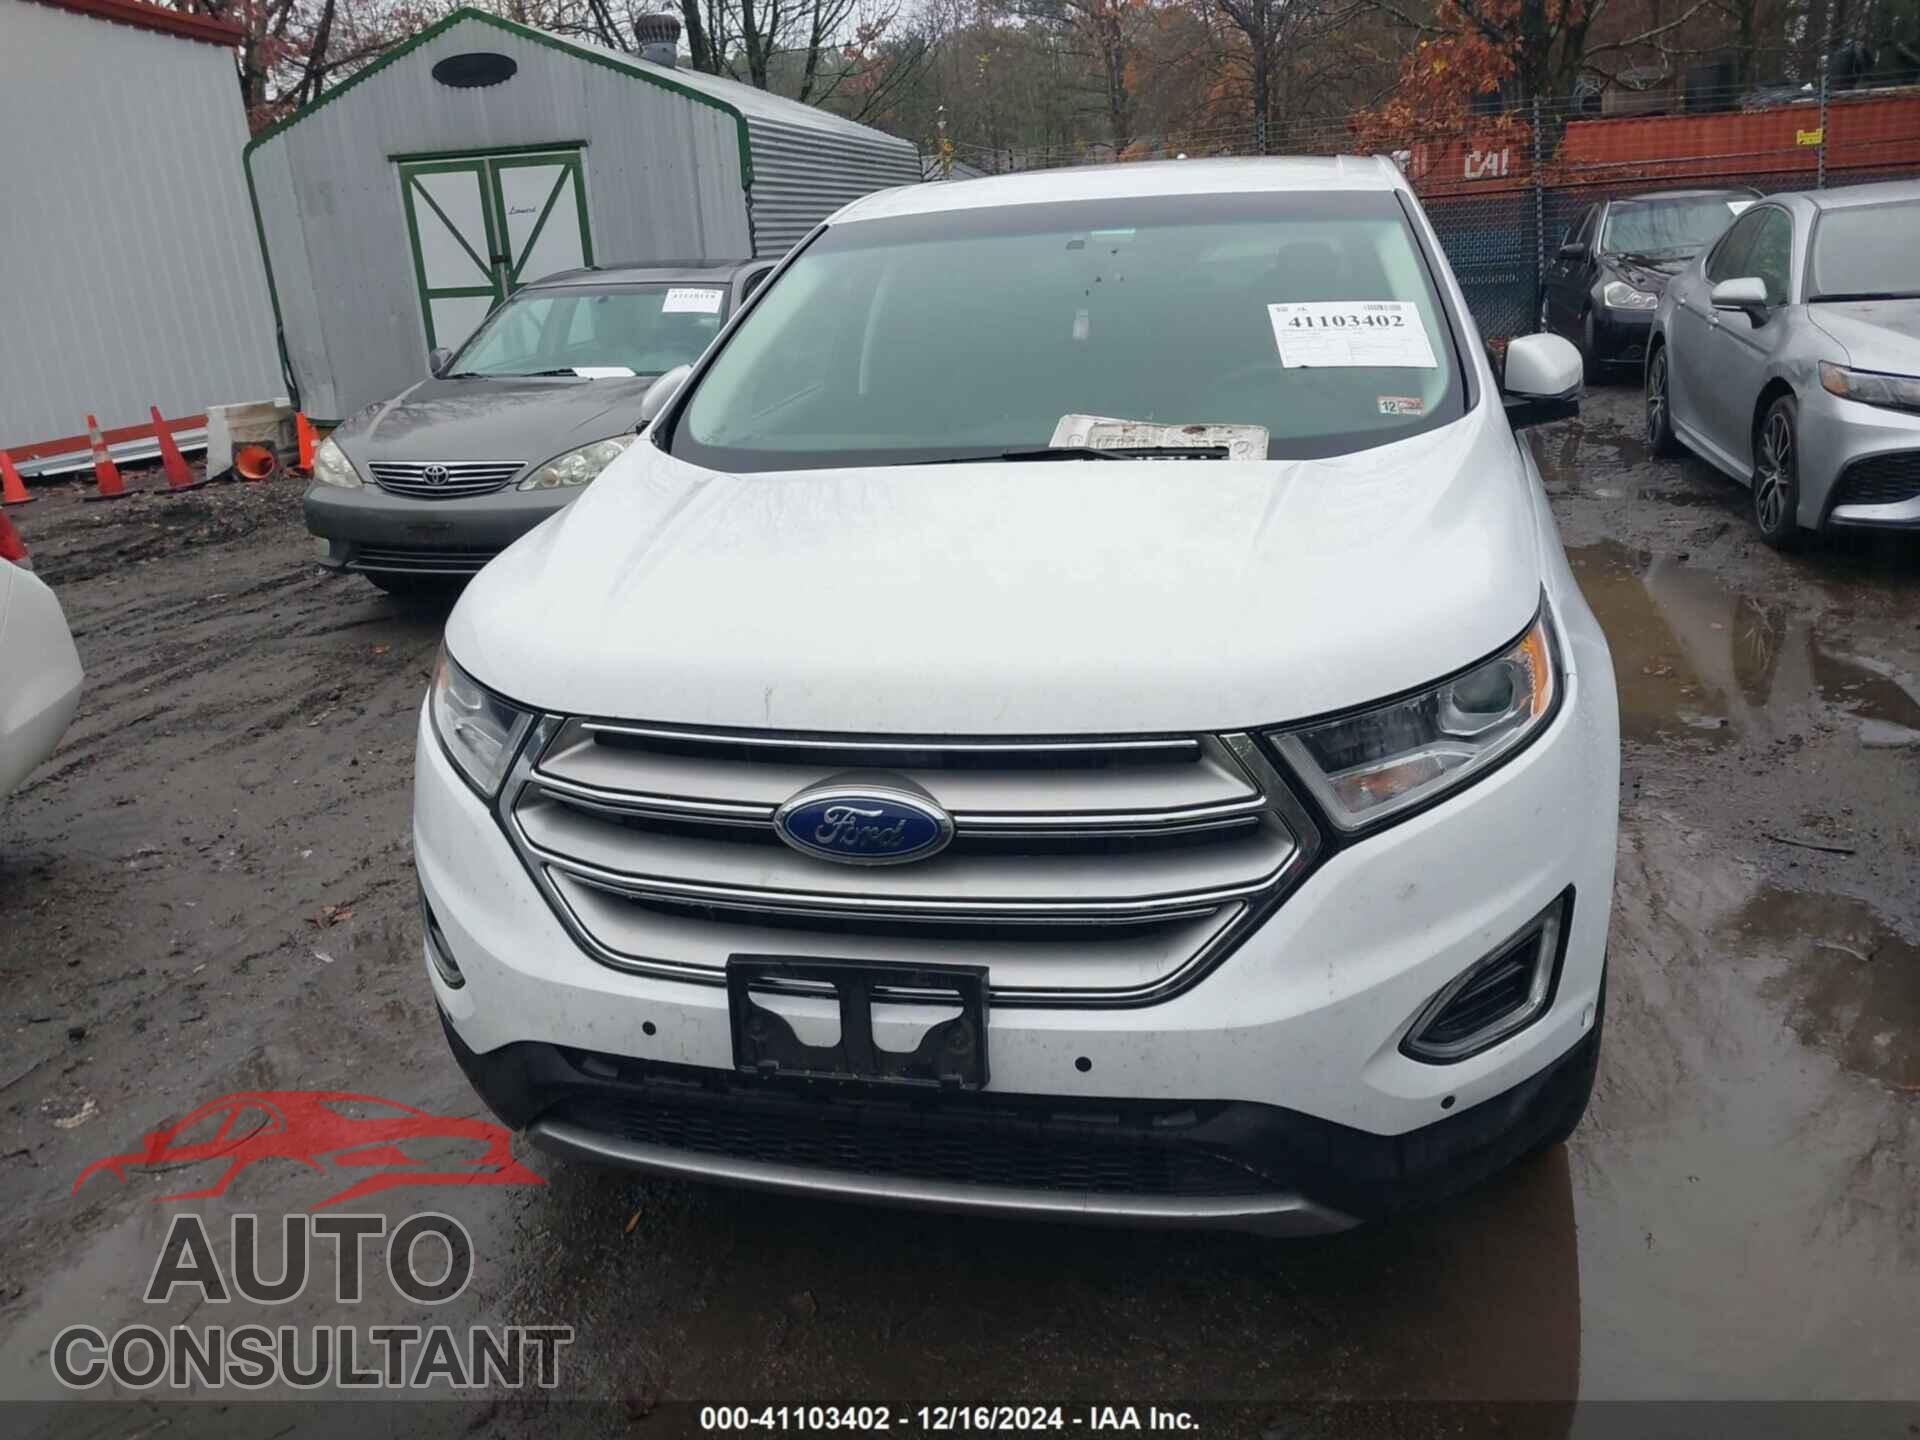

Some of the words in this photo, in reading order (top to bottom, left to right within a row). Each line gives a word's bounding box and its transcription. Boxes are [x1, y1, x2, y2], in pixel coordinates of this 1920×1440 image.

[1287, 315, 1405, 328] 41103402
[1382, 401, 1397, 413] 12
[814, 805, 907, 846] Ford
